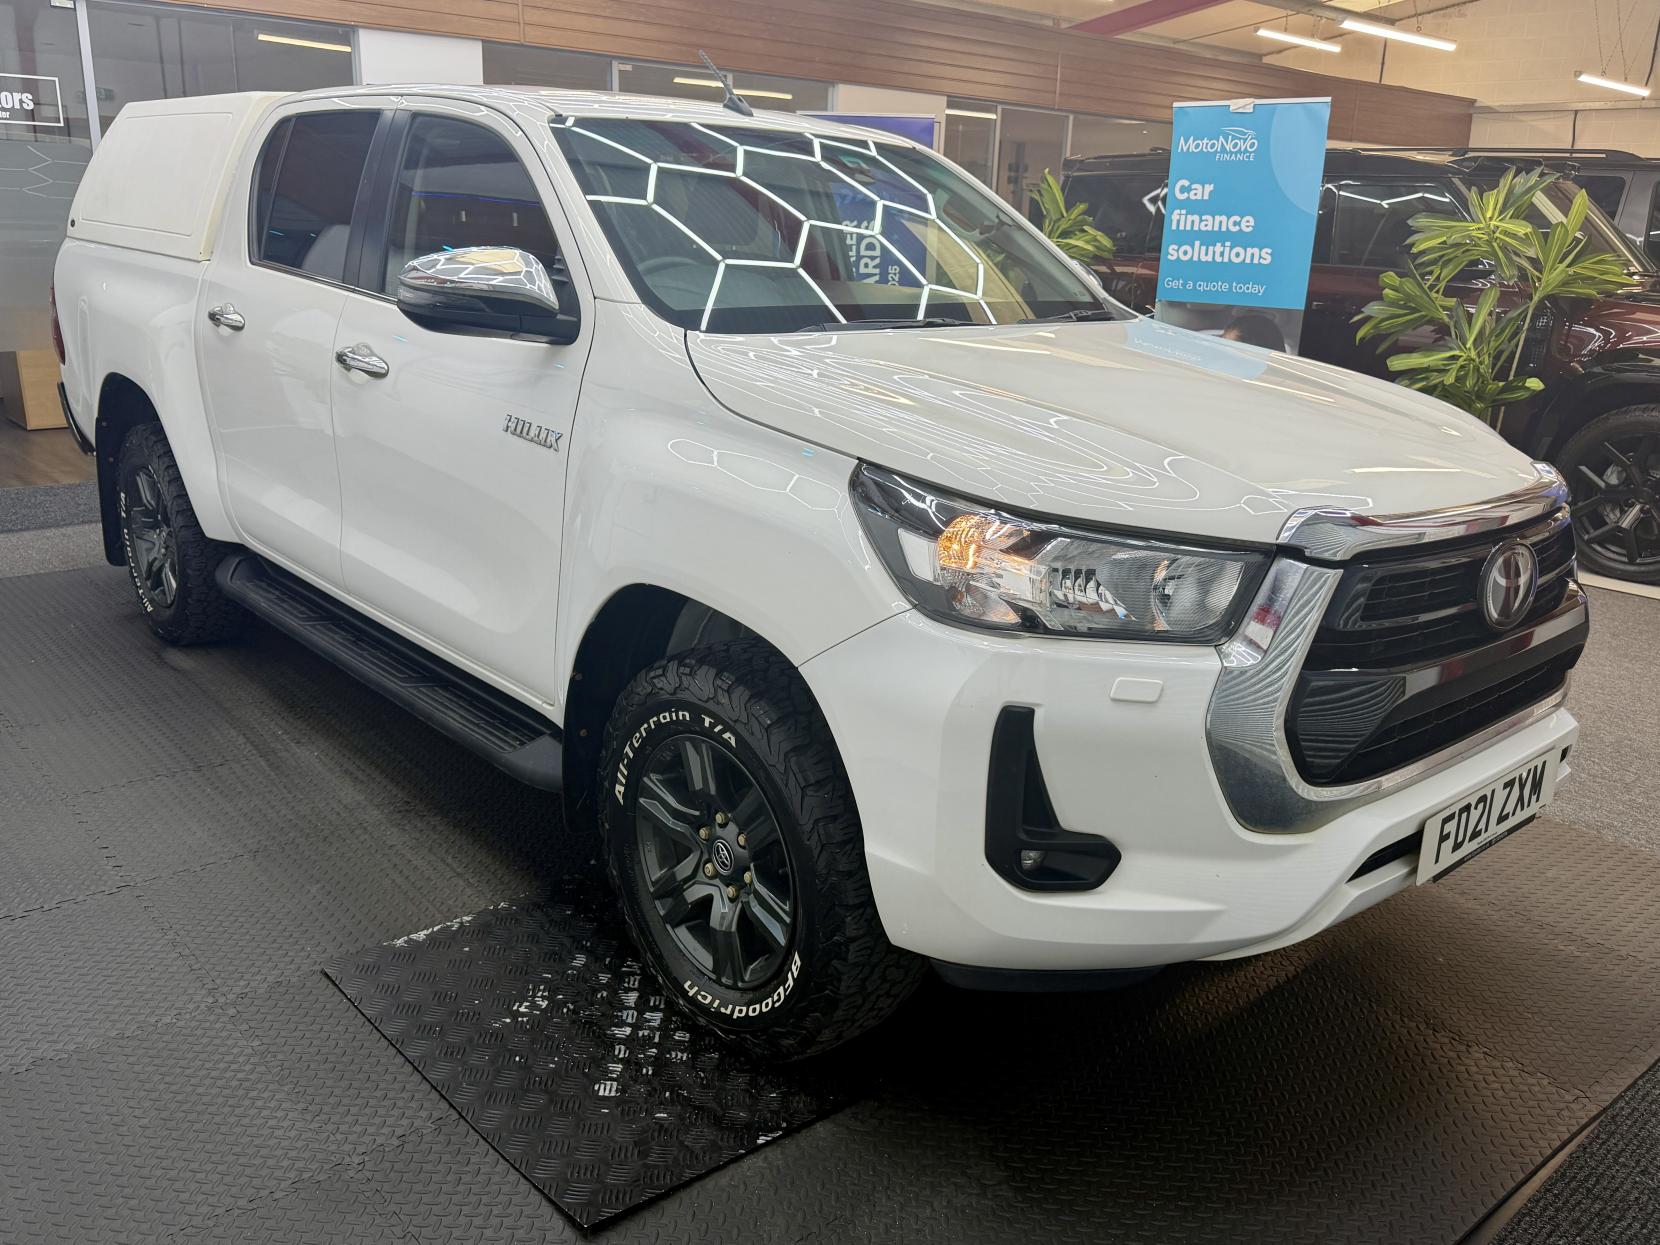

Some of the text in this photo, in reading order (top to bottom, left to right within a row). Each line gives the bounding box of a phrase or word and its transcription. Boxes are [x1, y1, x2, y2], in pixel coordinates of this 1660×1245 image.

[0, 91, 34, 110] ors
[1178, 134, 1258, 153] MotoNovo
[1216, 153, 1255, 161] FINANCE
[1174, 179, 1214, 200] Car
[1171, 209, 1254, 232] finance
[1167, 241, 1273, 265] solutions
[1164, 278, 1266, 296] Get a quote today
[614, 708, 737, 806] All-Terrain T/A
[1434, 788, 1496, 865] FD21
[1495, 760, 1547, 827] ZXM
[683, 950, 801, 1019] BFGoodrich
